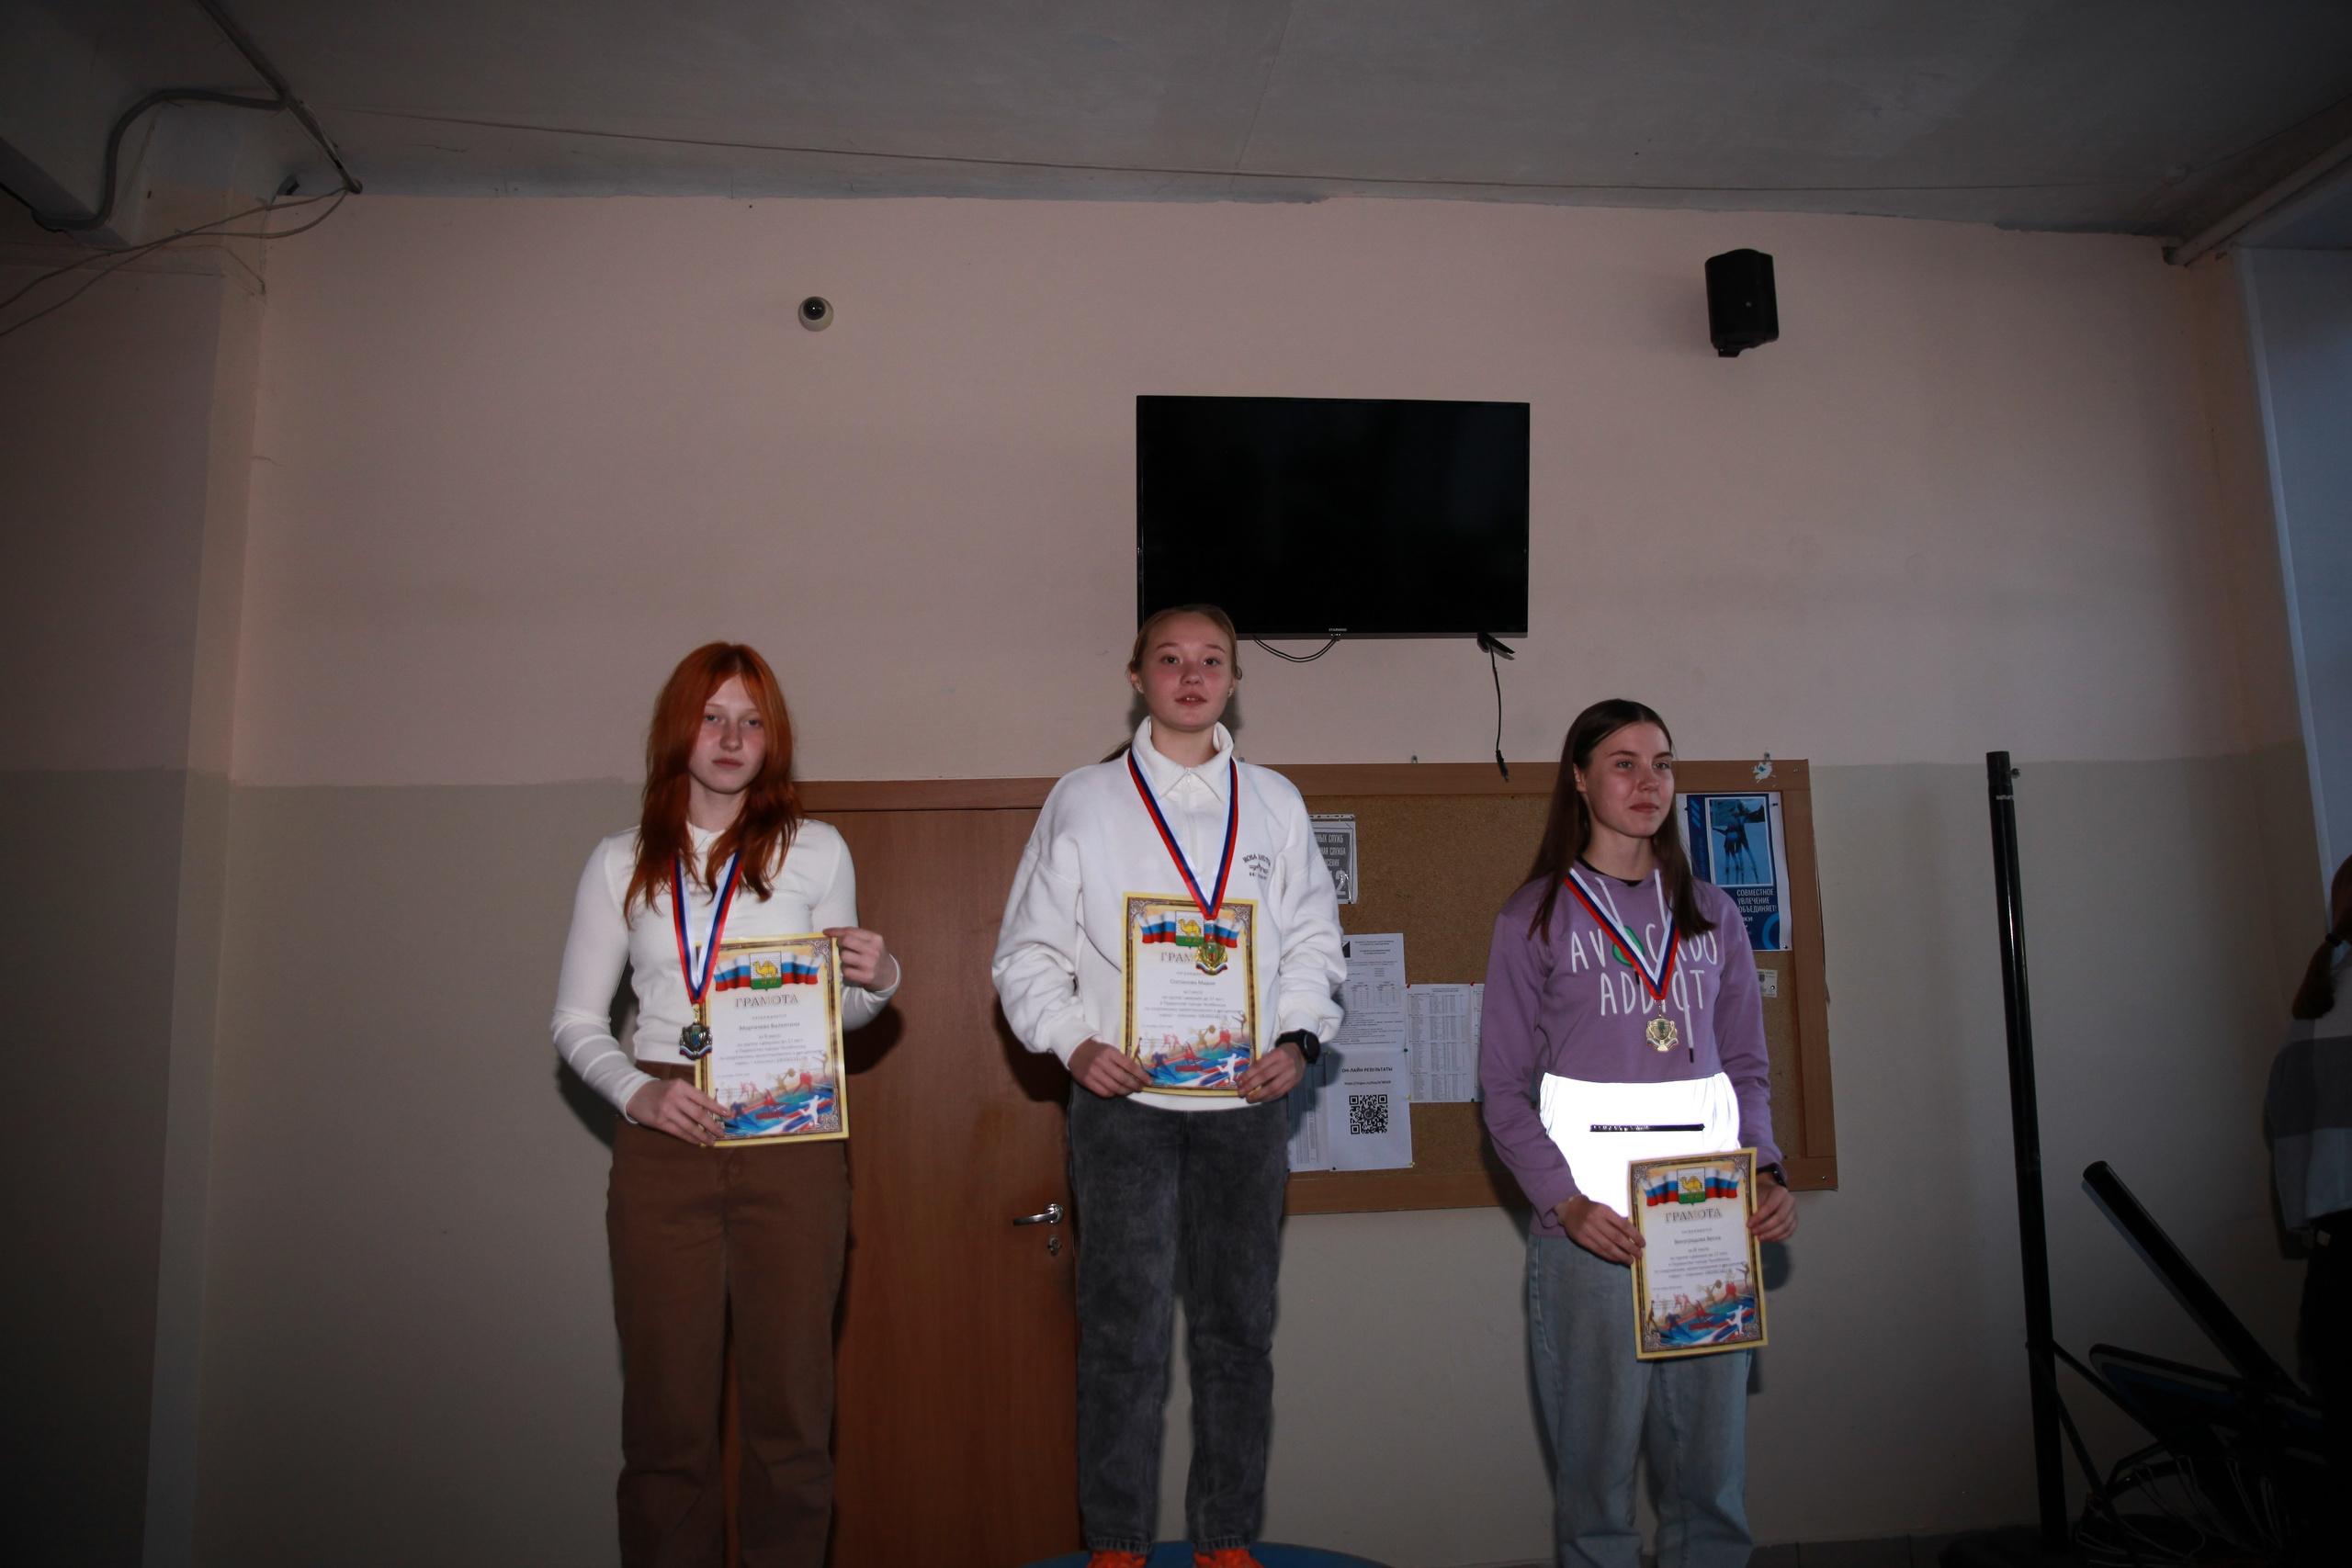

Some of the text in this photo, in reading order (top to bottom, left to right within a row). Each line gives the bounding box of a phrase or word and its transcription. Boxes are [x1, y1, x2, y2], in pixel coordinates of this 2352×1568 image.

[1736, 888, 1774, 897] СОВМЕСТНОЕ
[1737, 897, 1770, 905] УВЛЕЧЕНИЕ
[1738, 905, 1778, 913] ОБЪЕДИНЯЕТ!
[1160, 952, 1196, 963] ГРАМ
[1600, 969, 1704, 1016] ADDCT
[735, 994, 799, 1008] ГРАМОТА
[1665, 1208, 1722, 1223] ГРАМОТА
